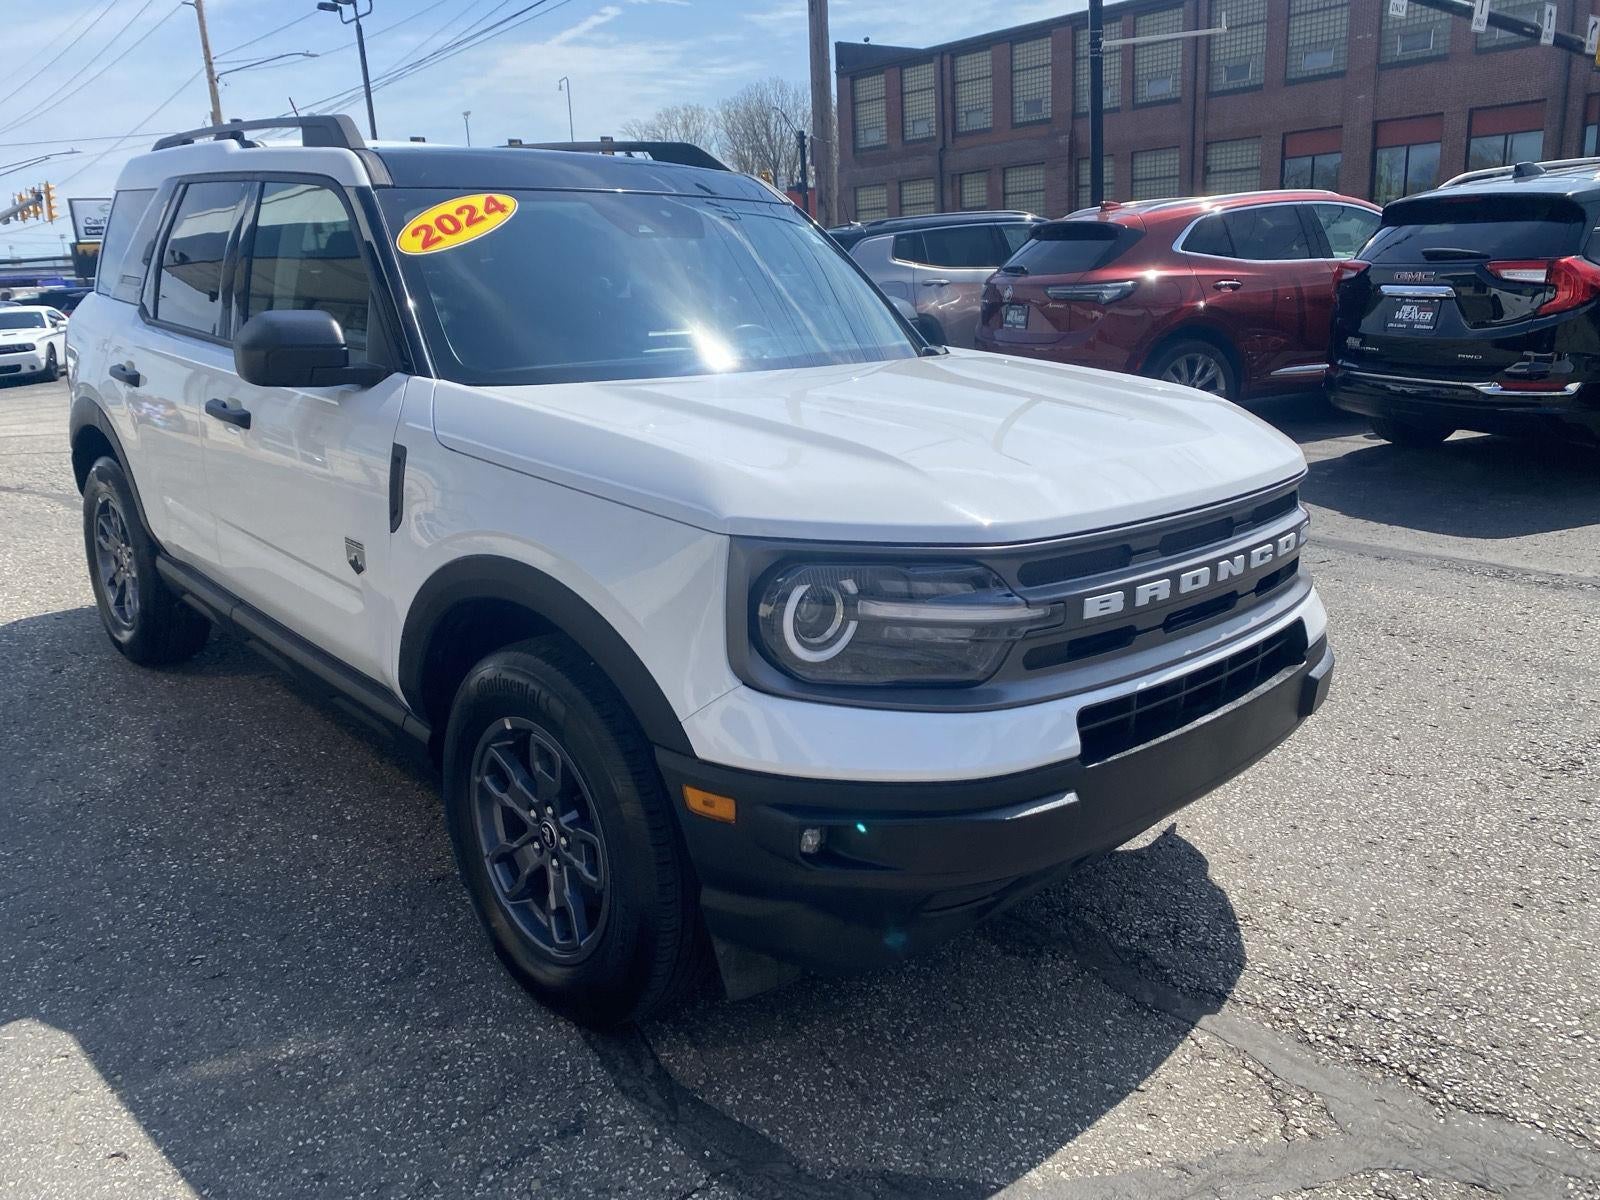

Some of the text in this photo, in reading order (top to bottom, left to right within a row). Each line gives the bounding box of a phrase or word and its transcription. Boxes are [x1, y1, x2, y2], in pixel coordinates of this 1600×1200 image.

[1391, 3, 1405, 13] ONLY
[411, 195, 508, 250] 2024
[1394, 271, 1436, 282] GMC
[1394, 311, 1434, 320] WEAVER
[1082, 532, 1296, 620] BRONCO
[476, 672, 541, 705] Continental
